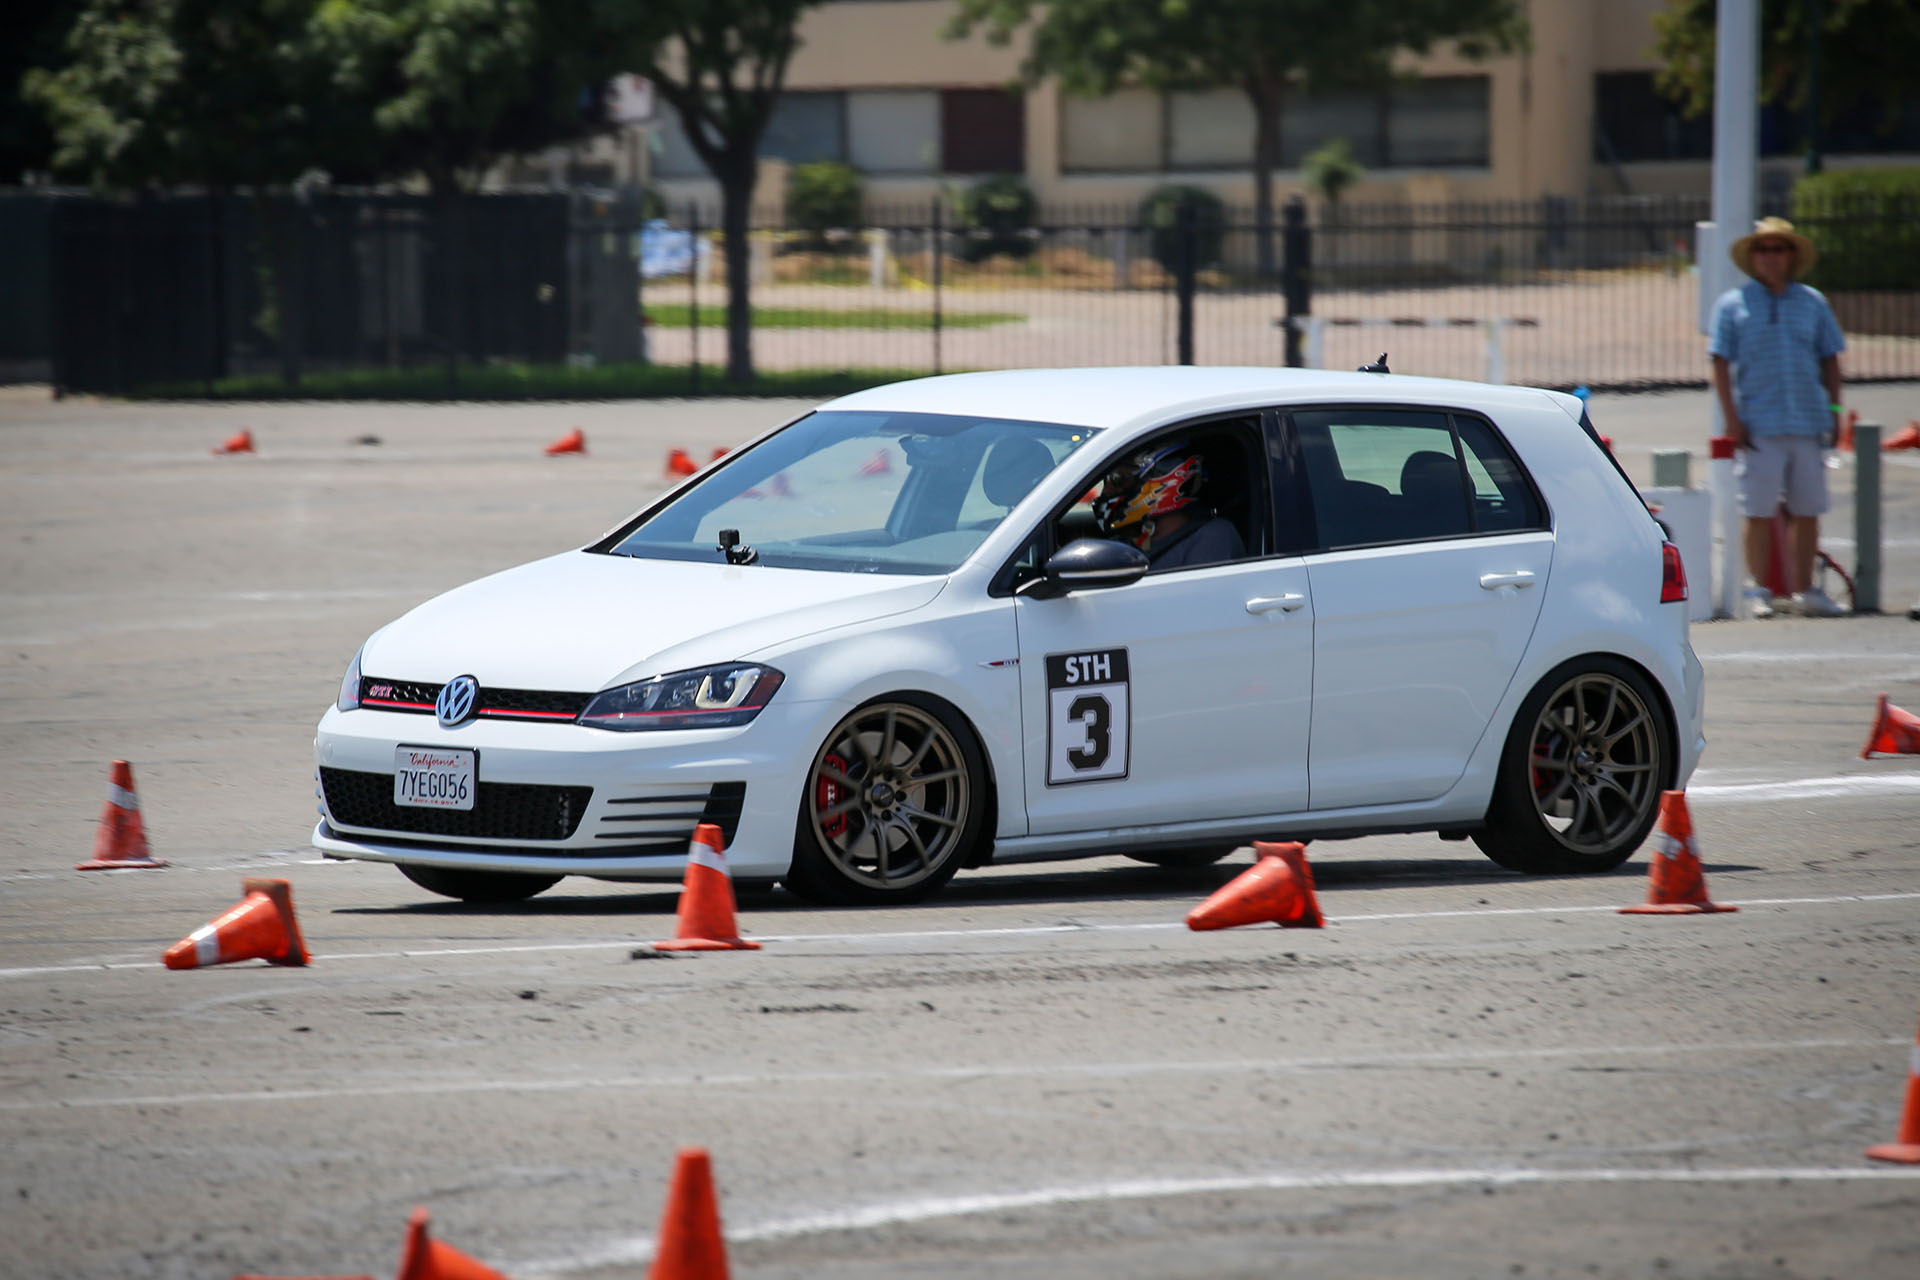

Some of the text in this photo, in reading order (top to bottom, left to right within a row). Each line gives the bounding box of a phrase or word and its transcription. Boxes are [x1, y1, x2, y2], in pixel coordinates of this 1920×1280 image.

[1065, 653, 1111, 684] STH
[1067, 693, 1112, 773] 3
[411, 752, 457, 769] California
[400, 770, 468, 800] 7YEG056
